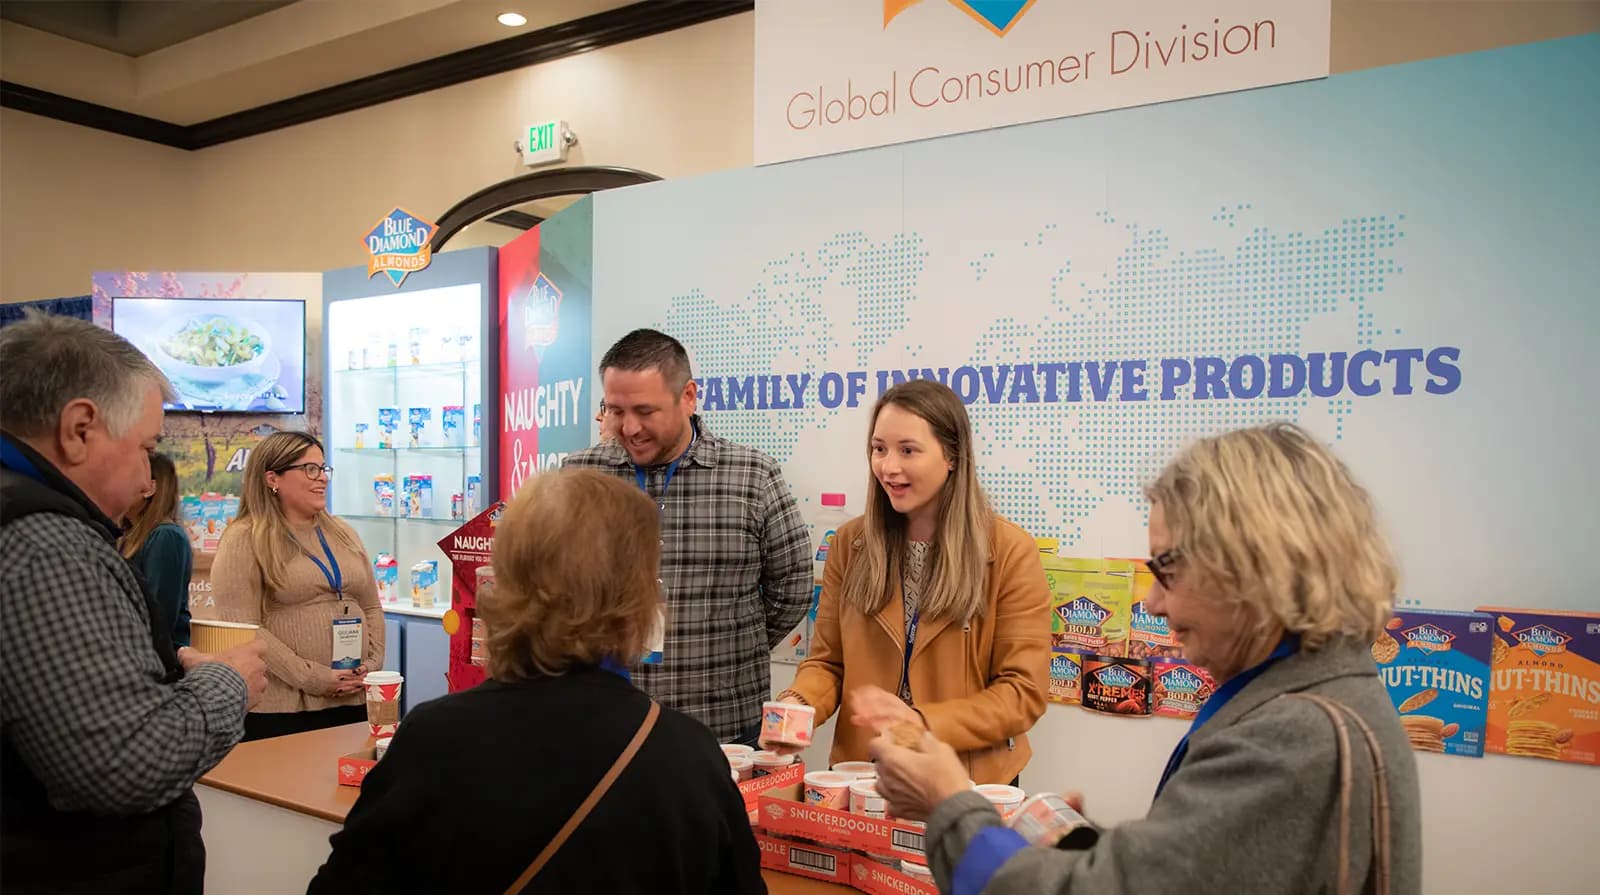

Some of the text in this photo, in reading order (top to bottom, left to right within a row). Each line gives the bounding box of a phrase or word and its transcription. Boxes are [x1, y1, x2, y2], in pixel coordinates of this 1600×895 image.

[786, 18, 1276, 131] Global Consumer Division
[529, 122, 555, 152] EXIT
[384, 217, 413, 237] BLUE
[369, 227, 428, 256] DIAMOND
[373, 253, 426, 269] ALMONDS
[694, 373, 811, 411] FAMILY
[818, 371, 867, 408] OF
[1159, 346, 1462, 400] PRODUCTS
[504, 377, 583, 433] NAUGHTY
[454, 535, 495, 551] NAUGH
[1073, 600, 1096, 612] BLUE
[1061, 607, 1106, 621] DIAMOND
[1069, 625, 1097, 635] BOLD
[1408, 631, 1450, 643] DIAMOND
[1418, 627, 1439, 637] BLUE
[1531, 627, 1553, 638] BLUE
[1520, 633, 1565, 645] DIAMOND
[1051, 665, 1080, 676] AMOND
[1171, 669, 1193, 681] BLUE
[1098, 673, 1137, 685] DIAMOND
[1160, 675, 1203, 689] DIAMOND
[1167, 691, 1195, 701] BOLD
[790, 807, 888, 837] SNICKERDOODLE
